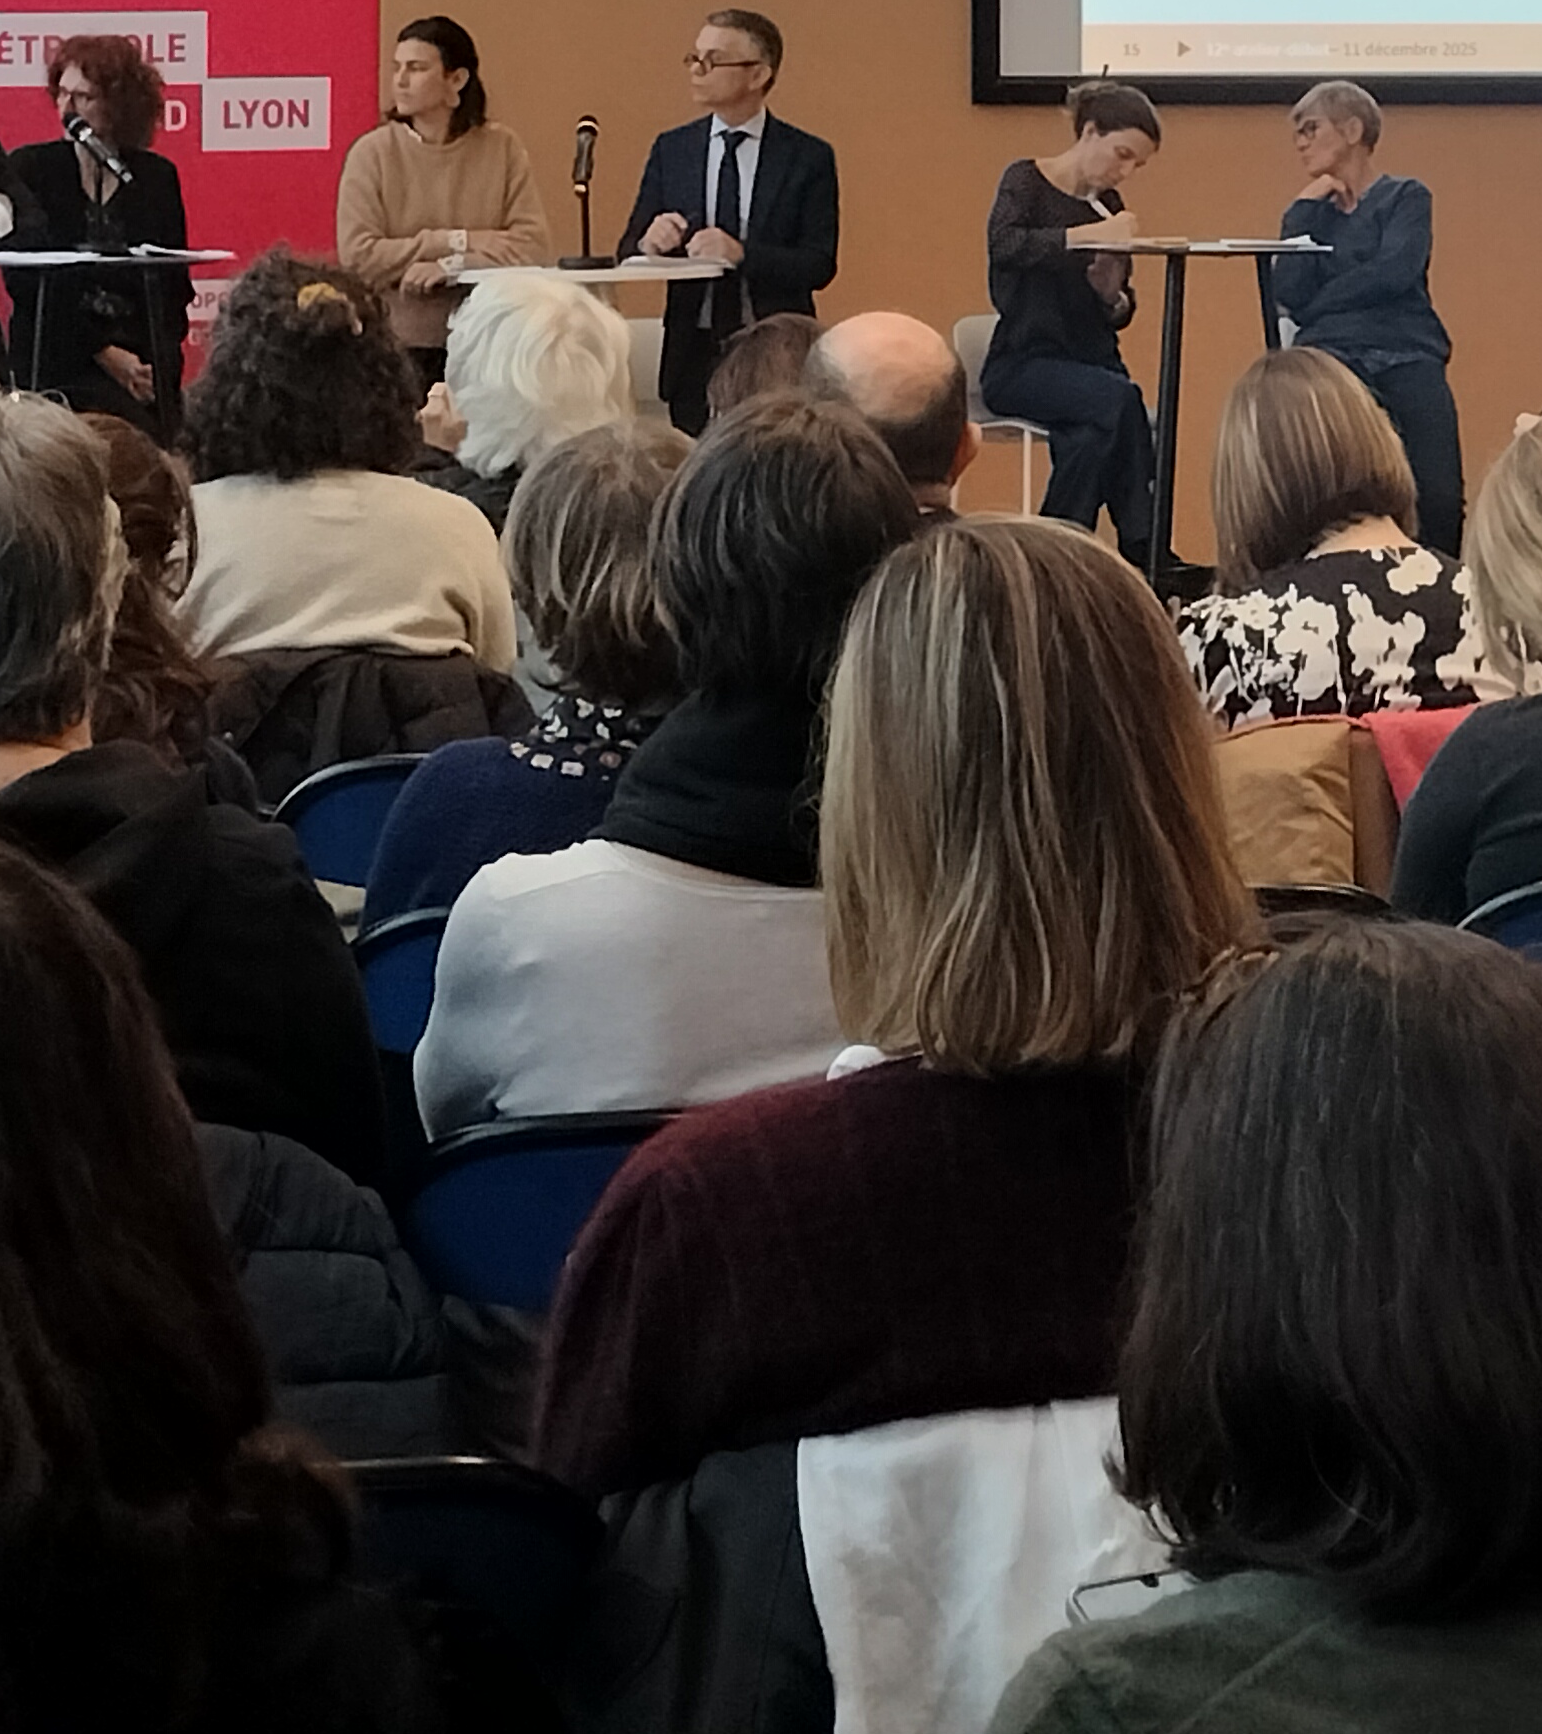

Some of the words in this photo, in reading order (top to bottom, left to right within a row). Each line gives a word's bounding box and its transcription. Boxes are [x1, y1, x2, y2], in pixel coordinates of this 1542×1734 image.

[1344, 43, 1360, 56] 11
[1365, 42, 1437, 56] décembre
[1443, 42, 1477, 56] 2025
[224, 99, 309, 129] LYON
